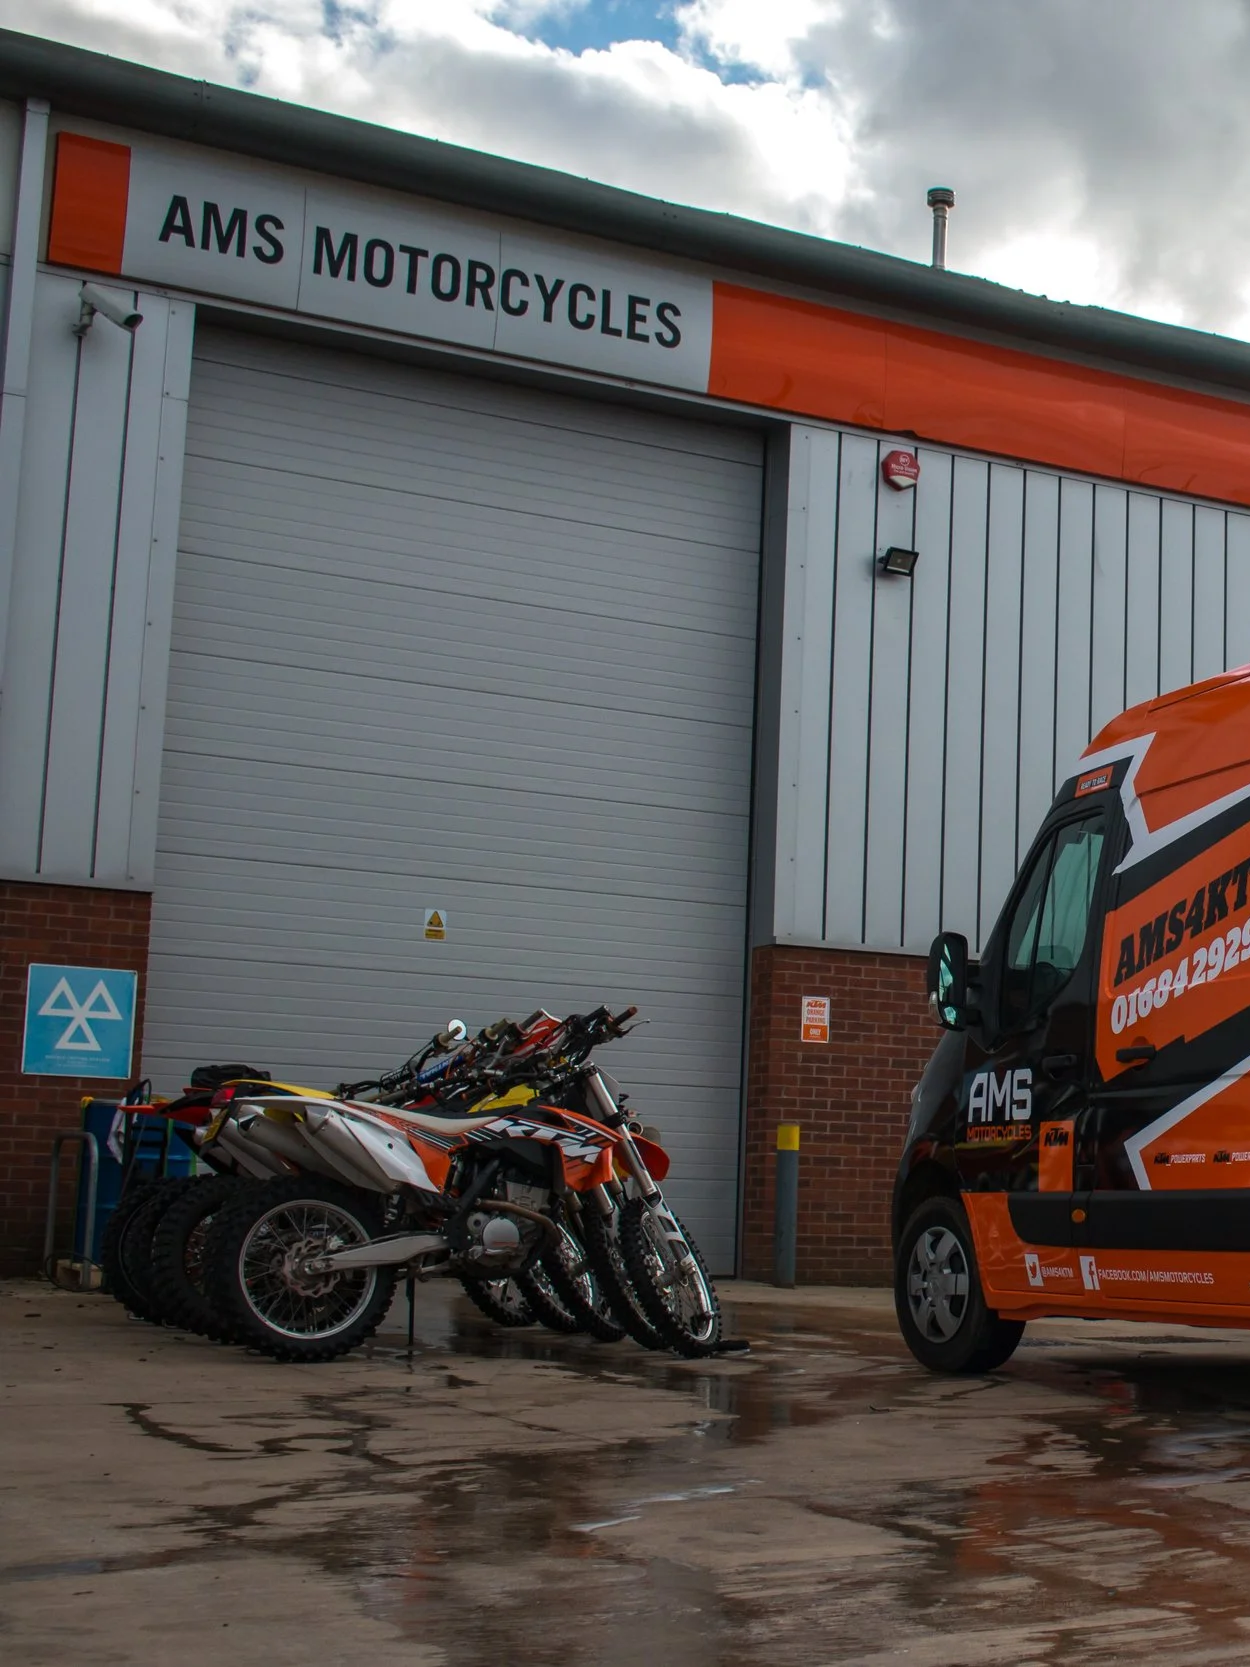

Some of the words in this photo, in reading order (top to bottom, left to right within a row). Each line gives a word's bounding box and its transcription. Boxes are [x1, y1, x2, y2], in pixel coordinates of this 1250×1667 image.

[159, 195, 285, 264] AMS
[312, 226, 682, 348] MOTORCYCLES
[1111, 957, 1189, 1034] 01684
[968, 1068, 1032, 1122] AMS
[966, 1125, 1032, 1142] MOTORCYCLES
[1044, 1128, 1069, 1147] KTM
[1170, 1154, 1206, 1164] POWERPARTS
[1041, 1266, 1073, 1278] @AMS4KTM
[1098, 1269, 1214, 1284] FACEBOOK.COM/AMSMOTORCYCLES
